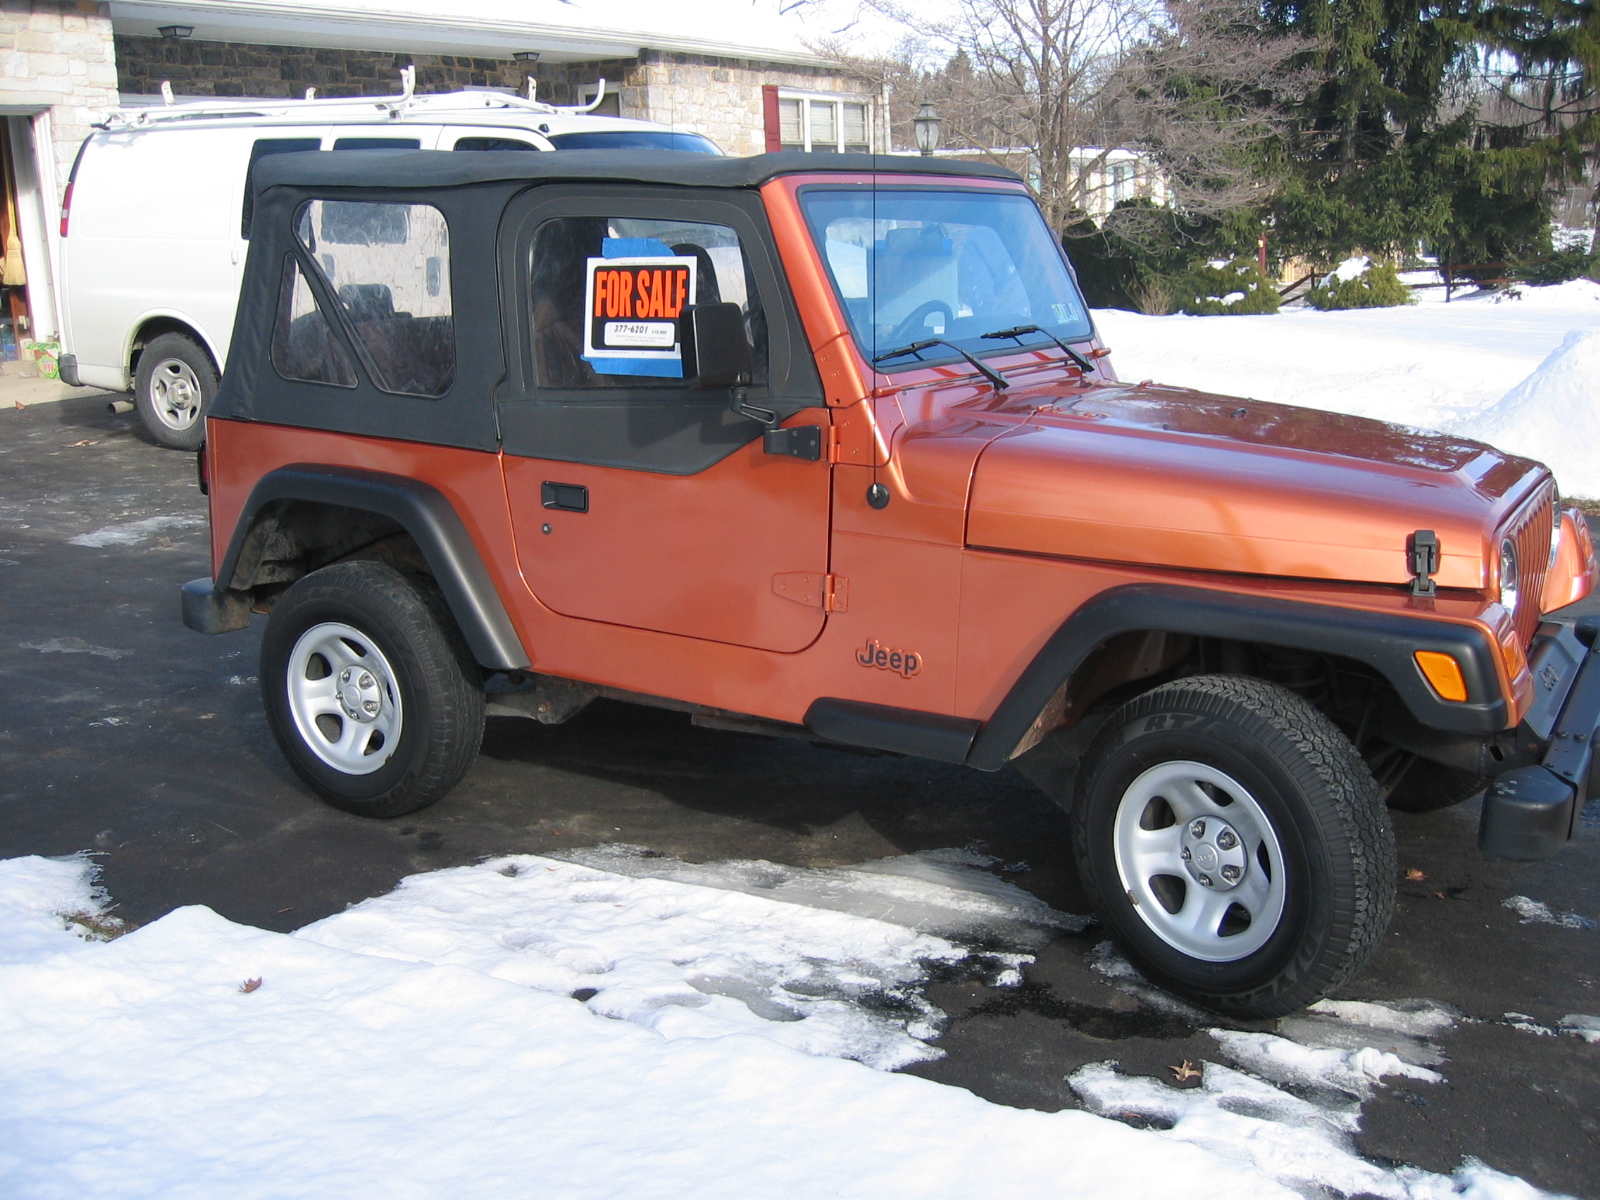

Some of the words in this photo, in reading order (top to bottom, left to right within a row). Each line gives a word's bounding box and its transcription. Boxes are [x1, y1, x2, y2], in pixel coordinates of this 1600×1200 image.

[595, 270, 633, 318] FOR
[635, 269, 688, 319] SALE
[613, 324, 649, 334] 377-6201
[858, 642, 918, 676] Jeep
